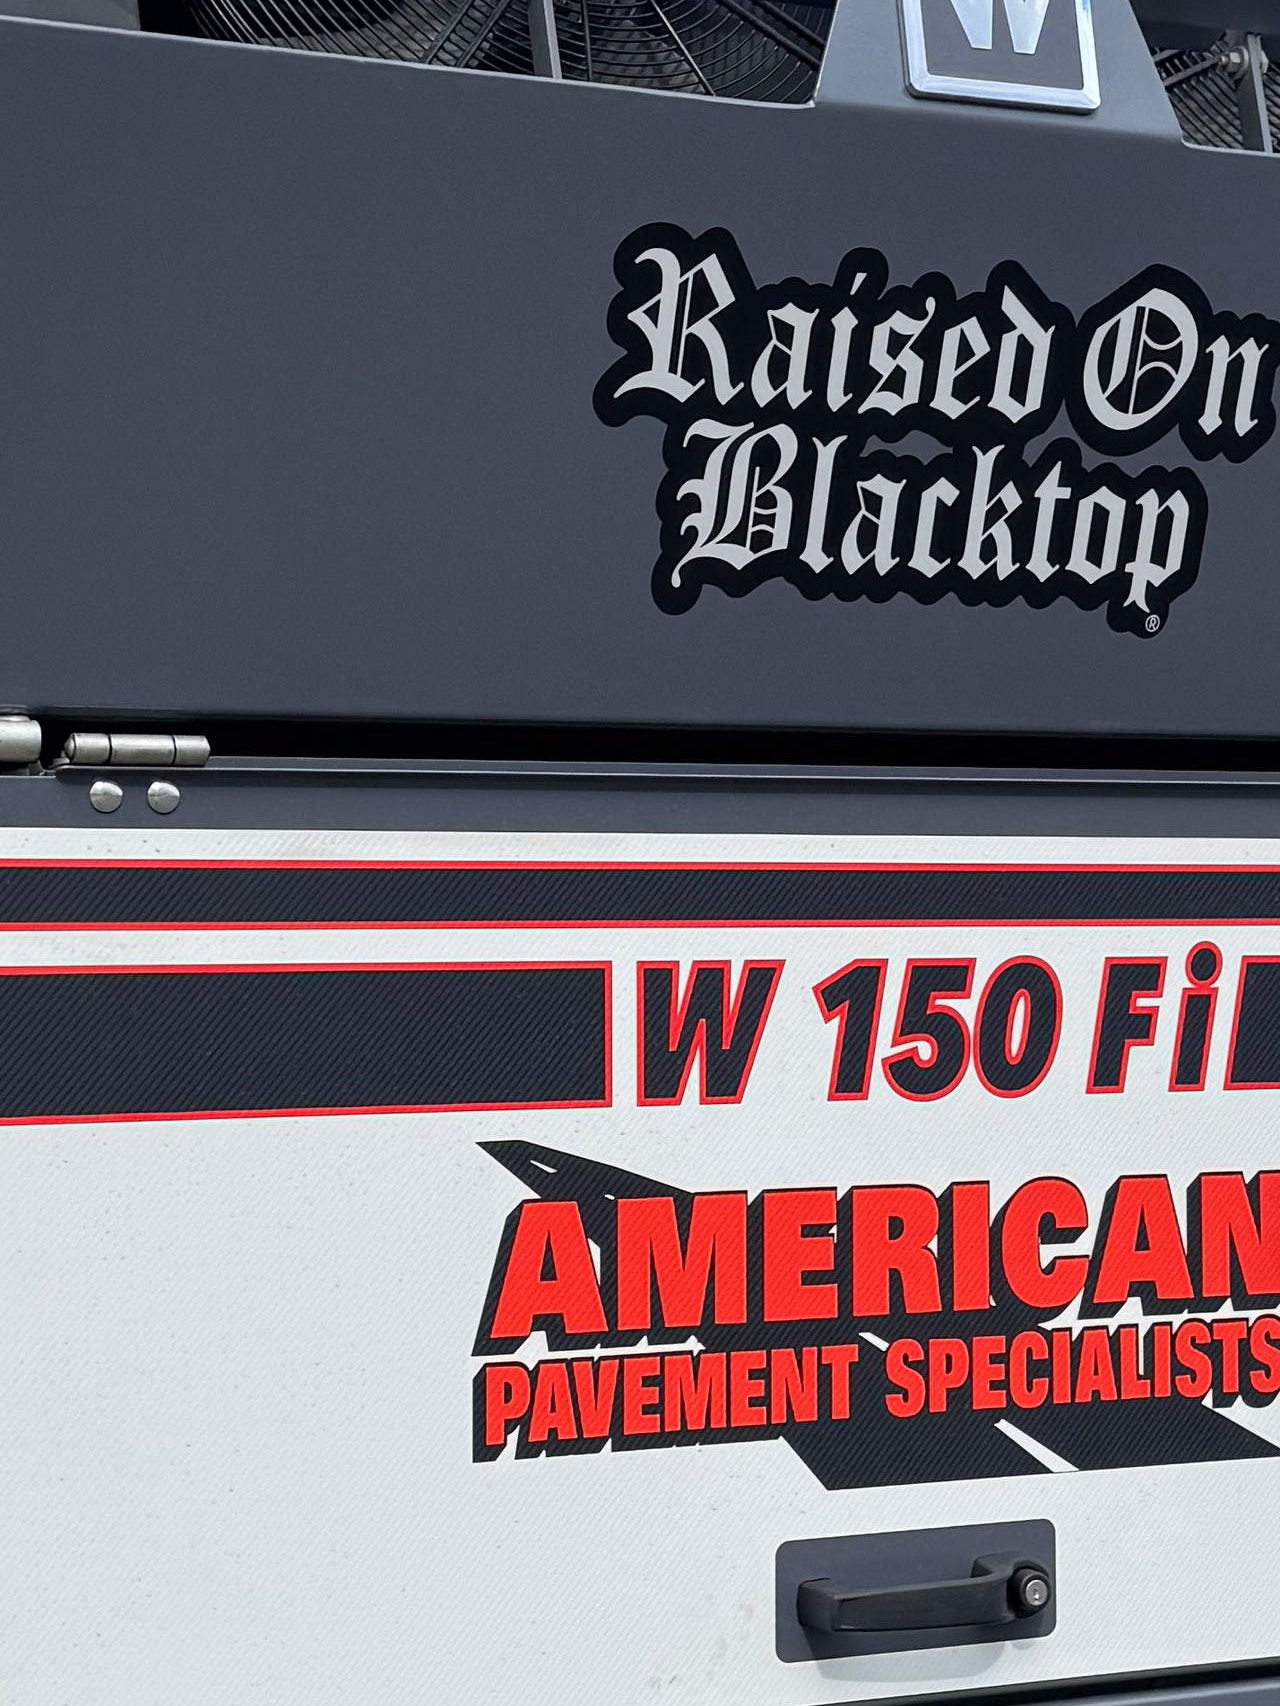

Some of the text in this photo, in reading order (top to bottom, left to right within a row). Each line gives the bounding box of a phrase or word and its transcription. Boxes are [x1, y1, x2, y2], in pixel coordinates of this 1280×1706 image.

[613, 247, 1270, 437] Raised On
[635, 941, 1224, 1107] W 150 Fi
[476, 1341, 862, 1461] PAVEMENT
